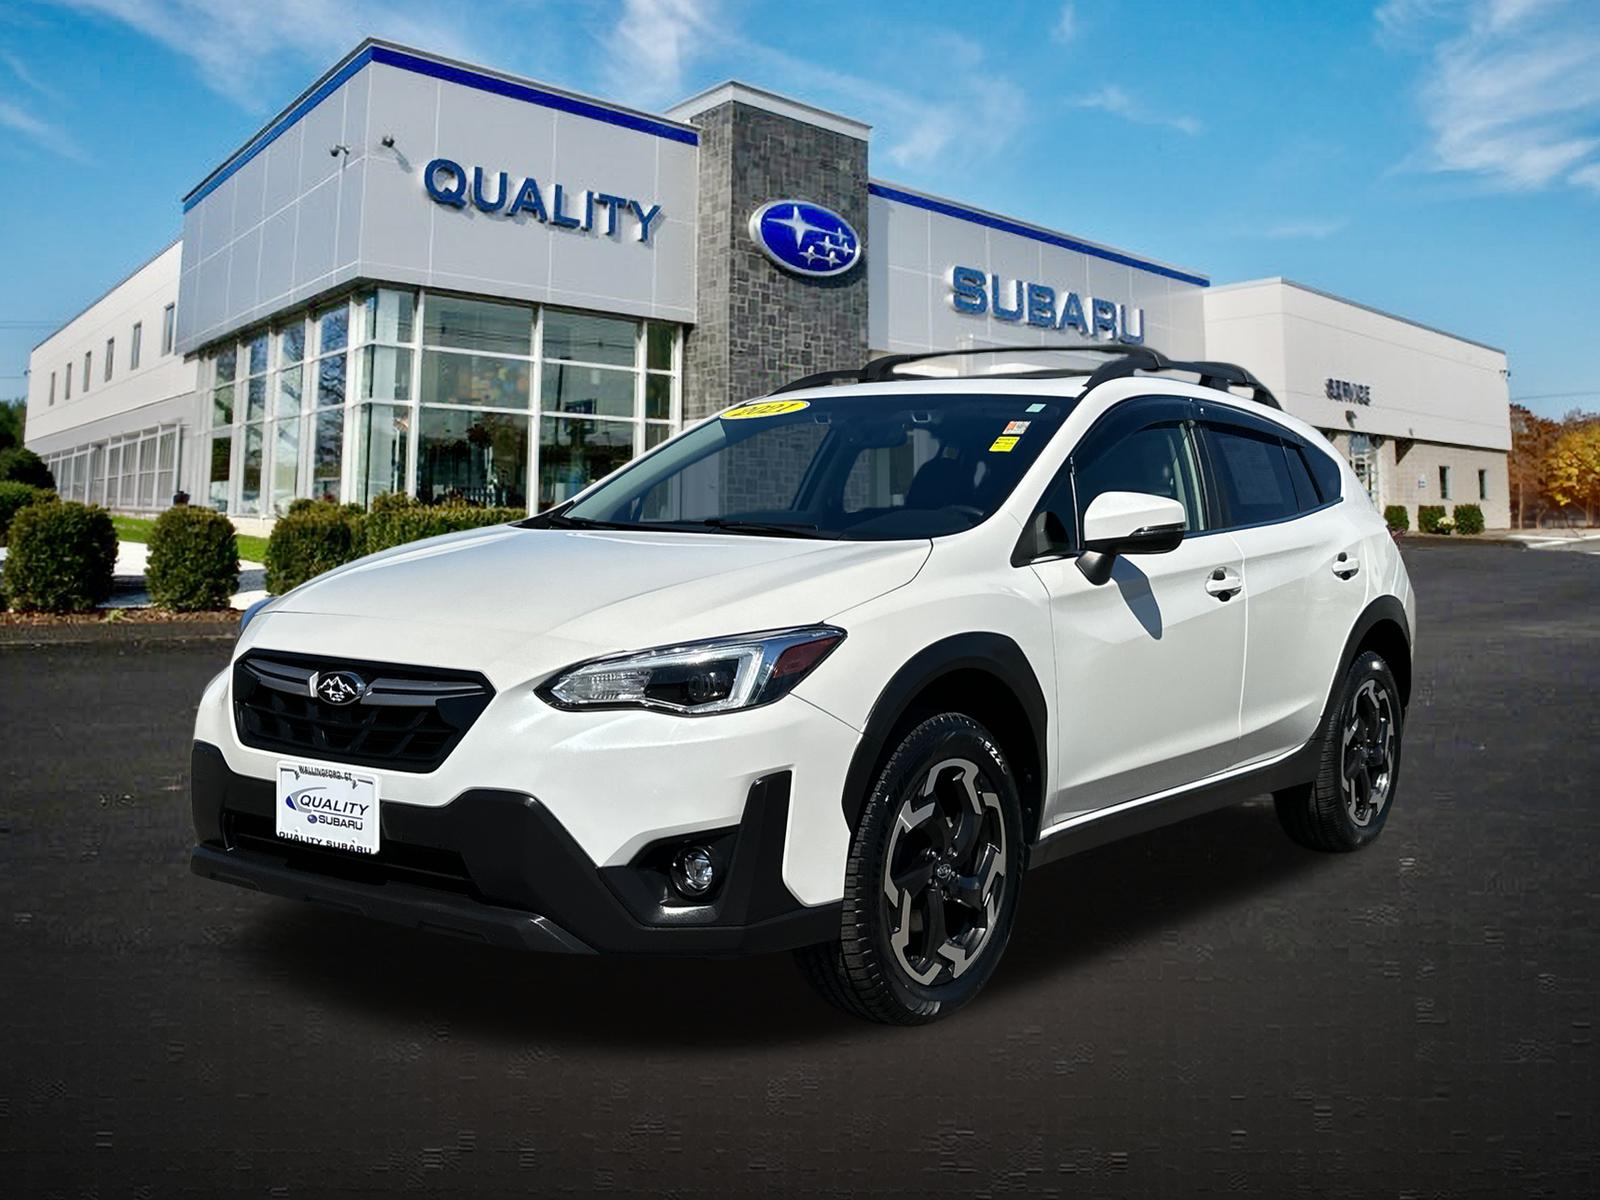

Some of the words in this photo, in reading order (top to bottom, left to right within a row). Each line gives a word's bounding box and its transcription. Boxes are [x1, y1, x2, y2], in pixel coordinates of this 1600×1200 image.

[424, 158, 661, 242] QUALITY
[948, 265, 1145, 345] SUBARU
[300, 795, 369, 816] QUALITY
[318, 815, 363, 831] SUBARU
[279, 831, 323, 846] QUALITY
[326, 840, 372, 854] SUBARU
